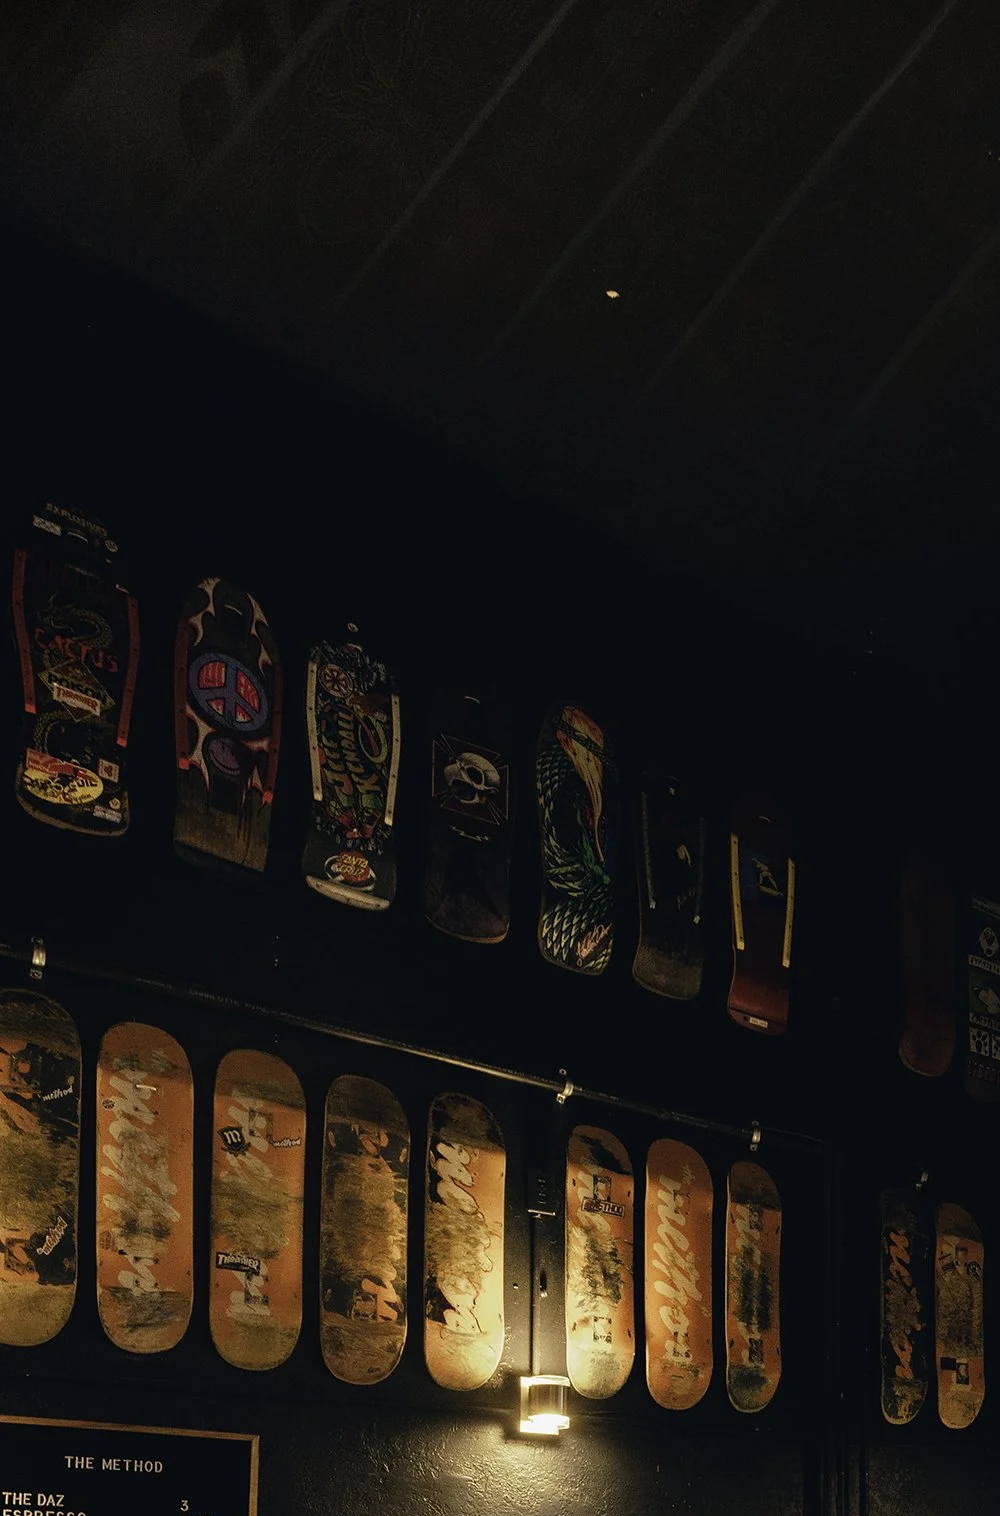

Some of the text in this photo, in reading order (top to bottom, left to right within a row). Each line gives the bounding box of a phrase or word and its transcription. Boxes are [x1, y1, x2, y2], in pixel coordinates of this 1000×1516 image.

[216, 1252, 260, 1271] THRASHER
[65, 1456, 163, 1473] THE METHOD
[2, 1492, 189, 1512] THE DAZ 3
